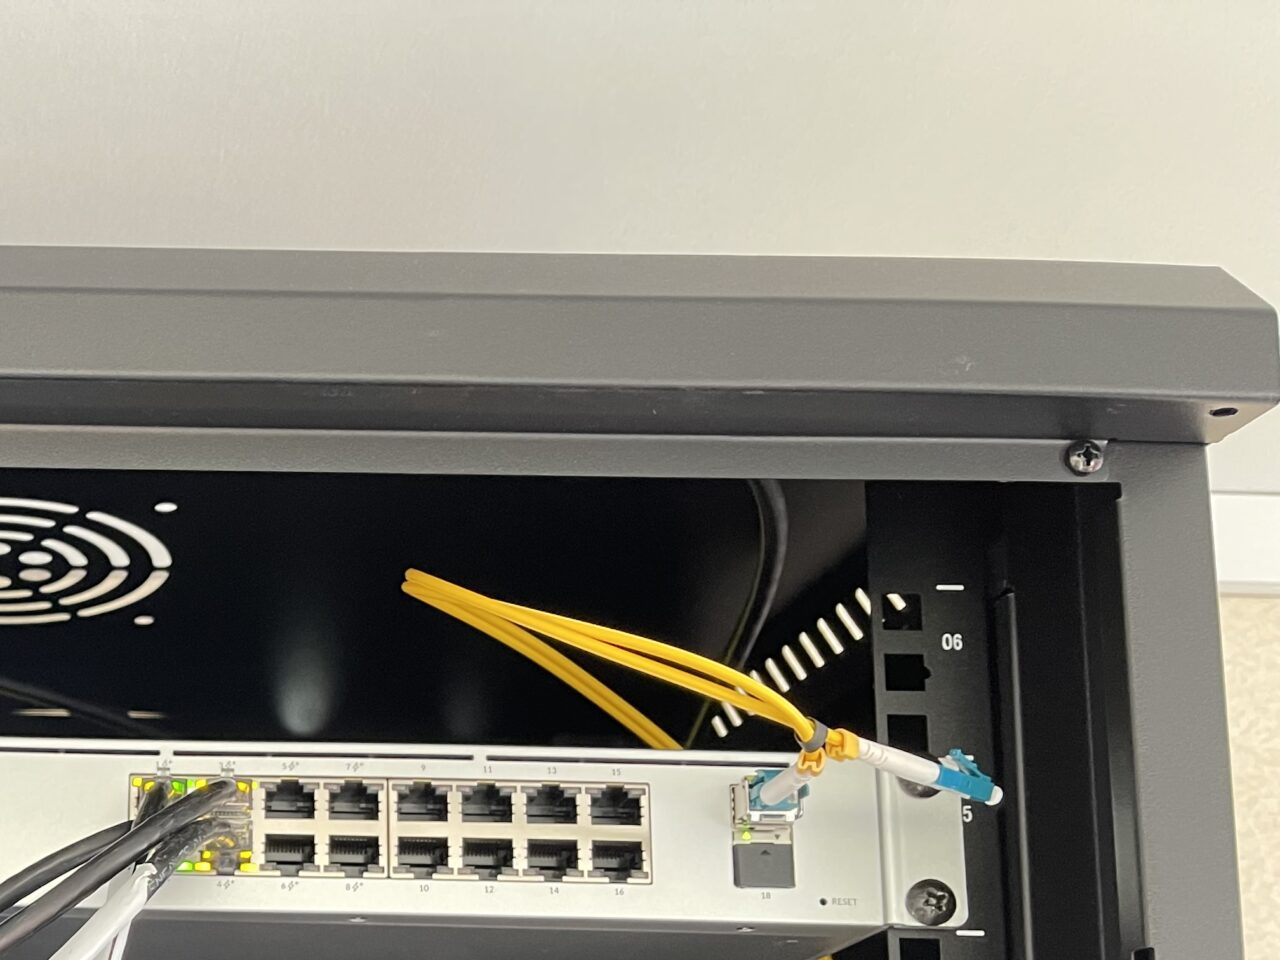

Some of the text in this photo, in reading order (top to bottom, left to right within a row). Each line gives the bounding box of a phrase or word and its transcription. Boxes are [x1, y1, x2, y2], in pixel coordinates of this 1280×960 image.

[941, 633, 964, 651] 06
[483, 766, 493, 774] 11
[547, 767, 557, 775] 13
[611, 768, 622, 776] 15
[962, 805, 973, 823] 5
[419, 884, 430, 893] 10
[484, 885, 495, 894] 12
[549, 886, 560, 895] 14
[614, 888, 625, 896] 16
[760, 891, 771, 900] 18
[831, 897, 857, 906] RESET
